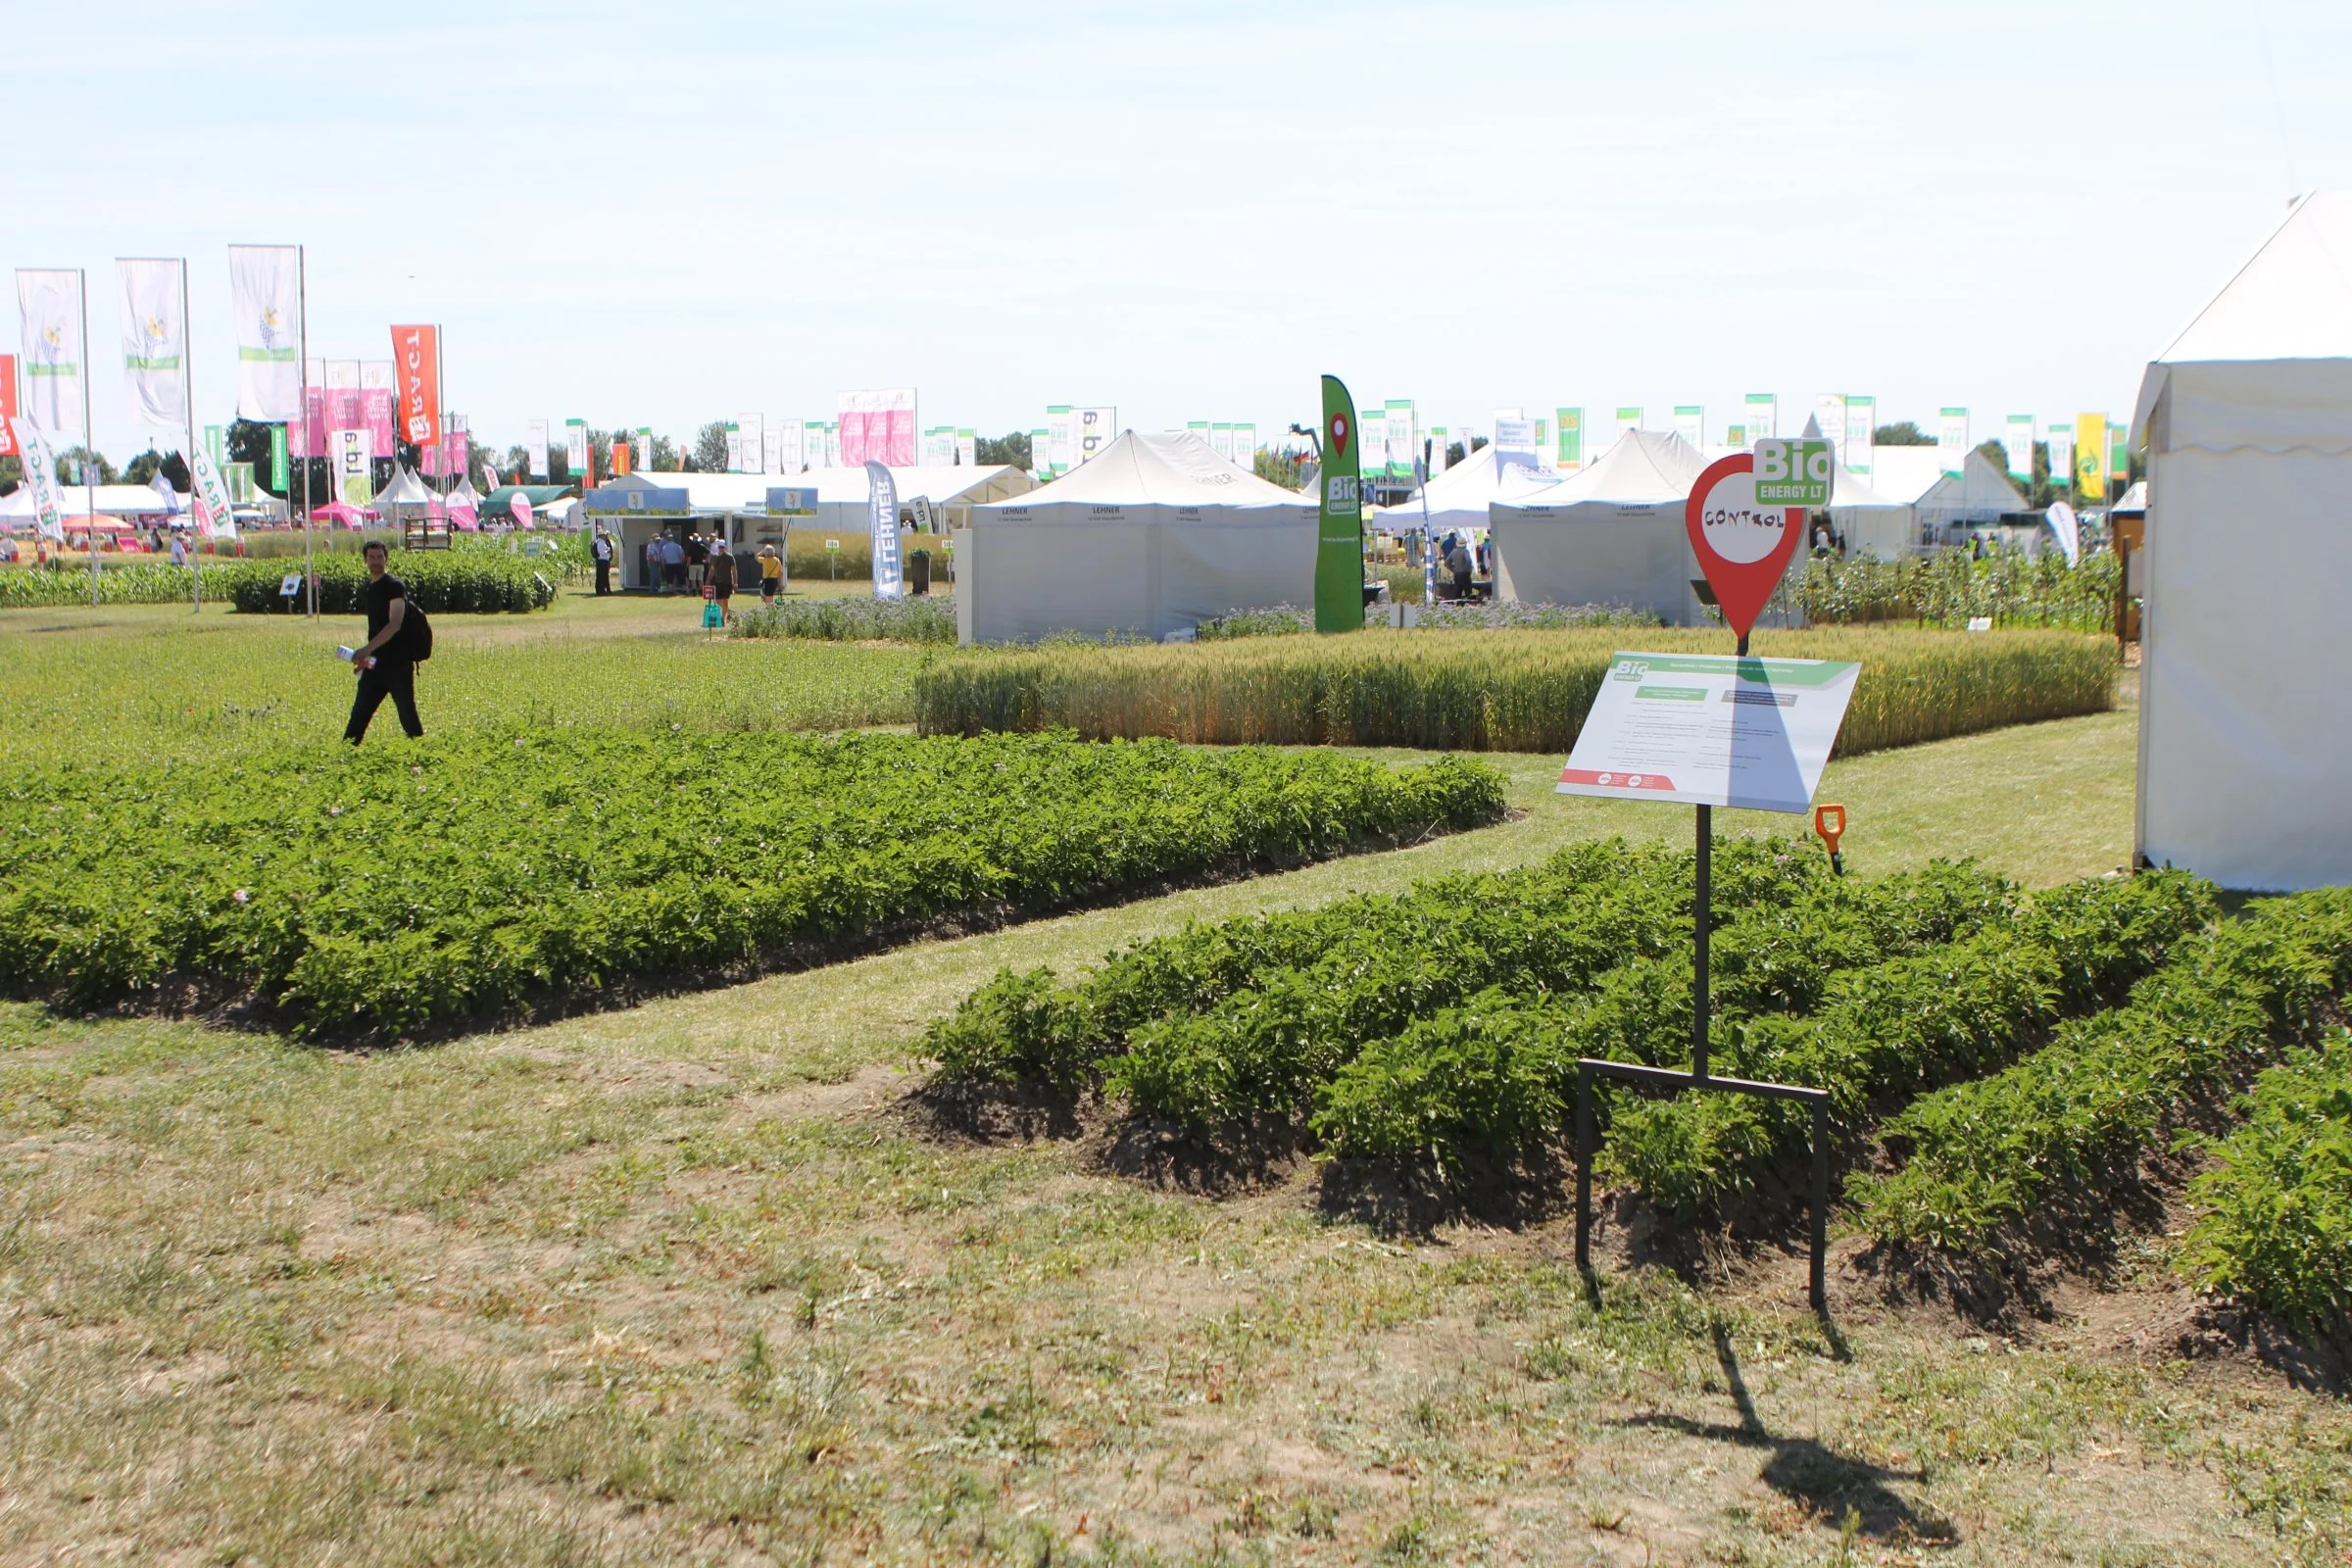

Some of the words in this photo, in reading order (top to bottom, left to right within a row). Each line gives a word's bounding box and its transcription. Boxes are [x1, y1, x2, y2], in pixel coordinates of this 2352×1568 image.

[1760, 485, 1806, 499] ENERGY
[1810, 485, 1823, 499] LT
[1093, 506, 1120, 514] LEHNER
[1705, 506, 1785, 528] CONTROL
